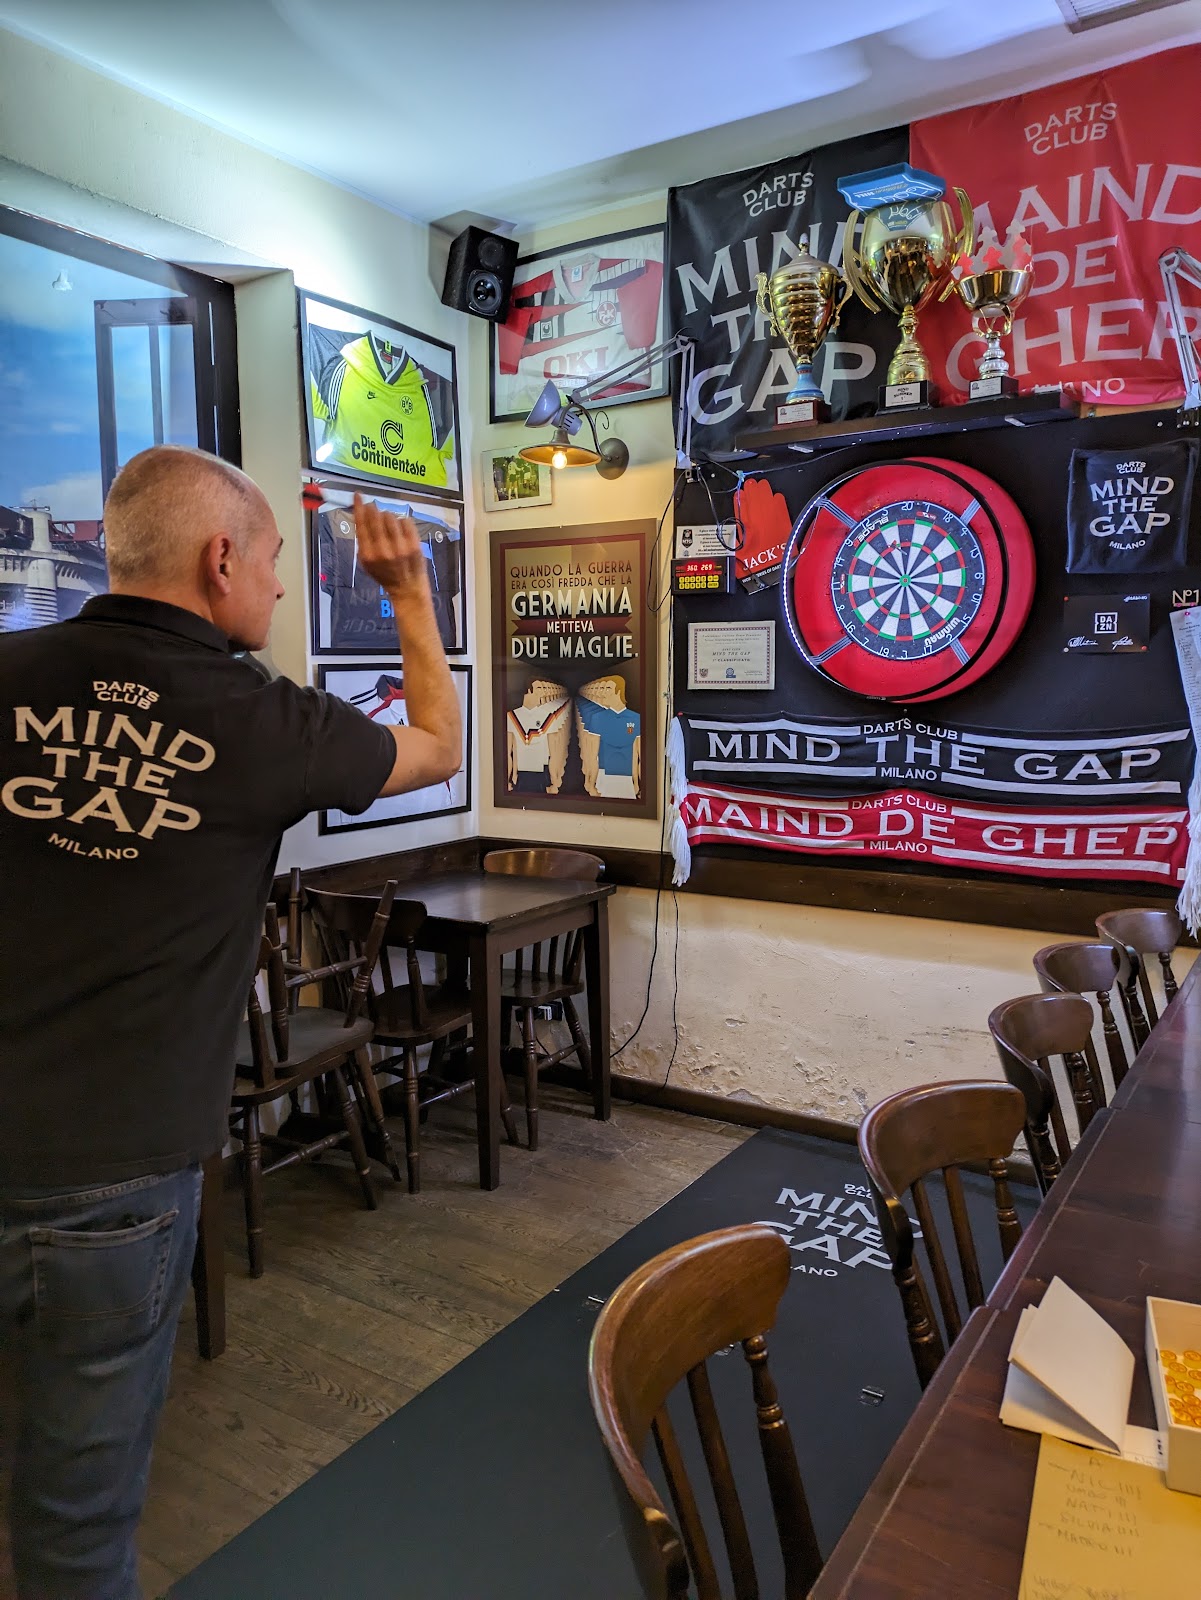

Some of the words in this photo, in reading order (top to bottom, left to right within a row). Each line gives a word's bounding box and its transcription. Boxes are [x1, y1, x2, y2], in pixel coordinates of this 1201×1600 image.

[1024, 102, 1118, 143] DARTS
[1032, 121, 1108, 156] CLUB
[742, 172, 814, 207] DARTS
[749, 190, 807, 217] CLUB
[543, 346, 609, 379] OKI
[687, 341, 877, 425] GAP
[361, 434, 376, 450] Die
[352, 442, 426, 476] Continentale
[1116, 461, 1146, 470] DARTS
[1090, 476, 1174, 502] MIND
[1102, 496, 1158, 515] THE
[1089, 513, 1170, 537] GAP
[743, 542, 786, 570] JACK'S
[1109, 540, 1146, 550] MILANO
[510, 564, 562, 578] QUANDO
[569, 563, 582, 575] LA
[588, 560, 632, 574] GUERRA
[512, 580, 527, 590] ERA
[532, 577, 554, 588] COSÌ
[558, 577, 593, 588] FREDDA
[598, 576, 616, 586] CHE
[621, 575, 632, 585] LA
[511, 586, 633, 616] GERMANIA
[547, 620, 594, 634] METTEVA
[511, 636, 549, 658] DUE
[560, 635, 639, 658] MAGLIE.
[93, 680, 160, 703] DARTS
[97, 691, 152, 710] CLUB
[13, 706, 216, 772] MIND
[863, 718, 912, 735] DARTS
[916, 722, 958, 740] CLUB
[707, 732, 841, 763] MIND
[864, 734, 986, 776] THE
[1014, 748, 1162, 781] GAP
[42, 745, 177, 797] THE
[881, 766, 938, 782] MILANO
[1, 776, 201, 840] GAP
[852, 795, 903, 812] DARTS
[906, 794, 948, 813] CLUB
[686, 798, 855, 836] MAIND
[878, 809, 956, 845] DE
[981, 825, 1178, 856] GHEP
[48, 833, 139, 860] MILANO
[869, 840, 928, 854] MILANO
[789, 1208, 883, 1249] THE
